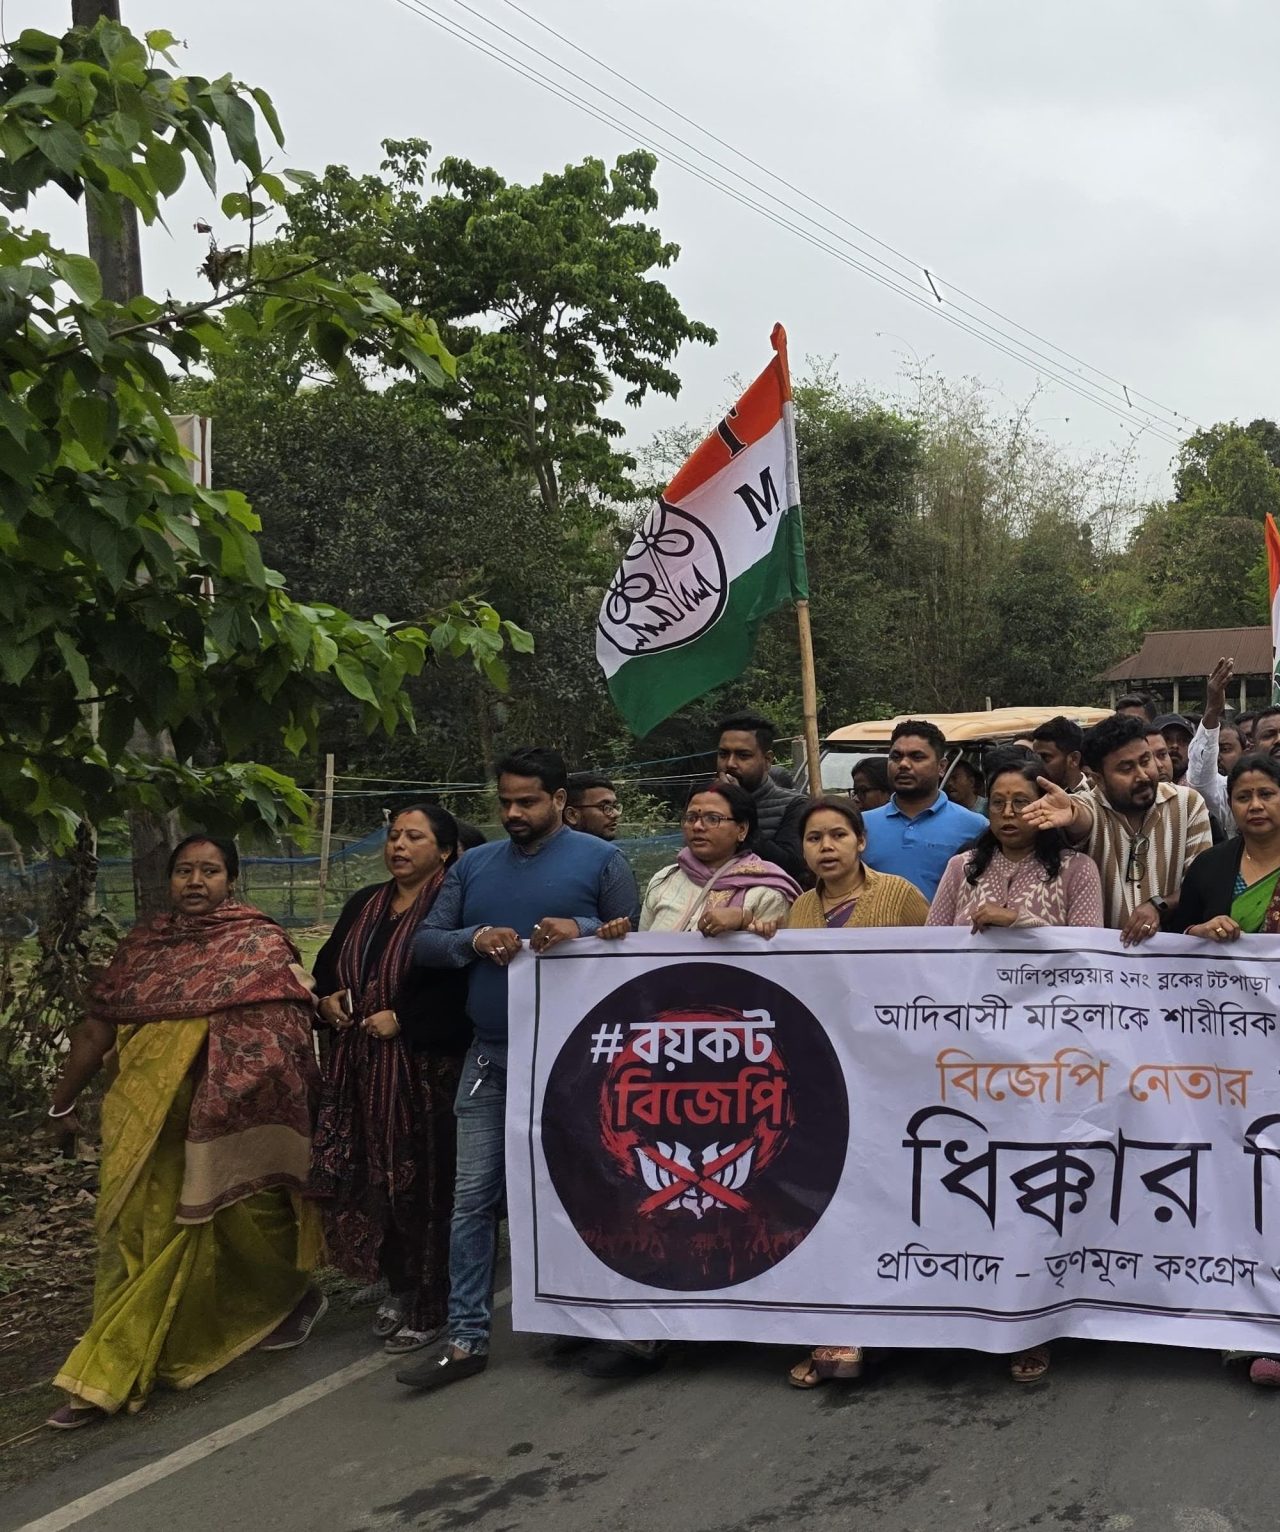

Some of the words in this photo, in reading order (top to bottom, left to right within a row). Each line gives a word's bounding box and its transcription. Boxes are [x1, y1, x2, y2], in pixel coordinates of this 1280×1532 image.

[733, 465, 780, 532] M
[996, 963, 1114, 988] আলিপুরদুয়ার
[1119, 970, 1151, 988] ২নং
[1157, 971, 1204, 991] ব্লকের
[1206, 969, 1272, 997] টটপাড়া
[591, 1009, 775, 1071] #বয়কট
[873, 993, 1013, 1032] আদিবাসী
[1023, 994, 1150, 1033] মহিলাকে
[1159, 998, 1278, 1038] শারীরিক
[614, 1067, 787, 1126] বিজেপি
[936, 1047, 1110, 1105] বিজেপি
[1128, 1062, 1252, 1108] নেতার
[901, 1105, 1213, 1238] ধিক্কার
[876, 1242, 1005, 1284] প্রতিবাদে
[1044, 1245, 1144, 1289] তৃণমূল
[1152, 1254, 1259, 1288] কংগ্রেস
